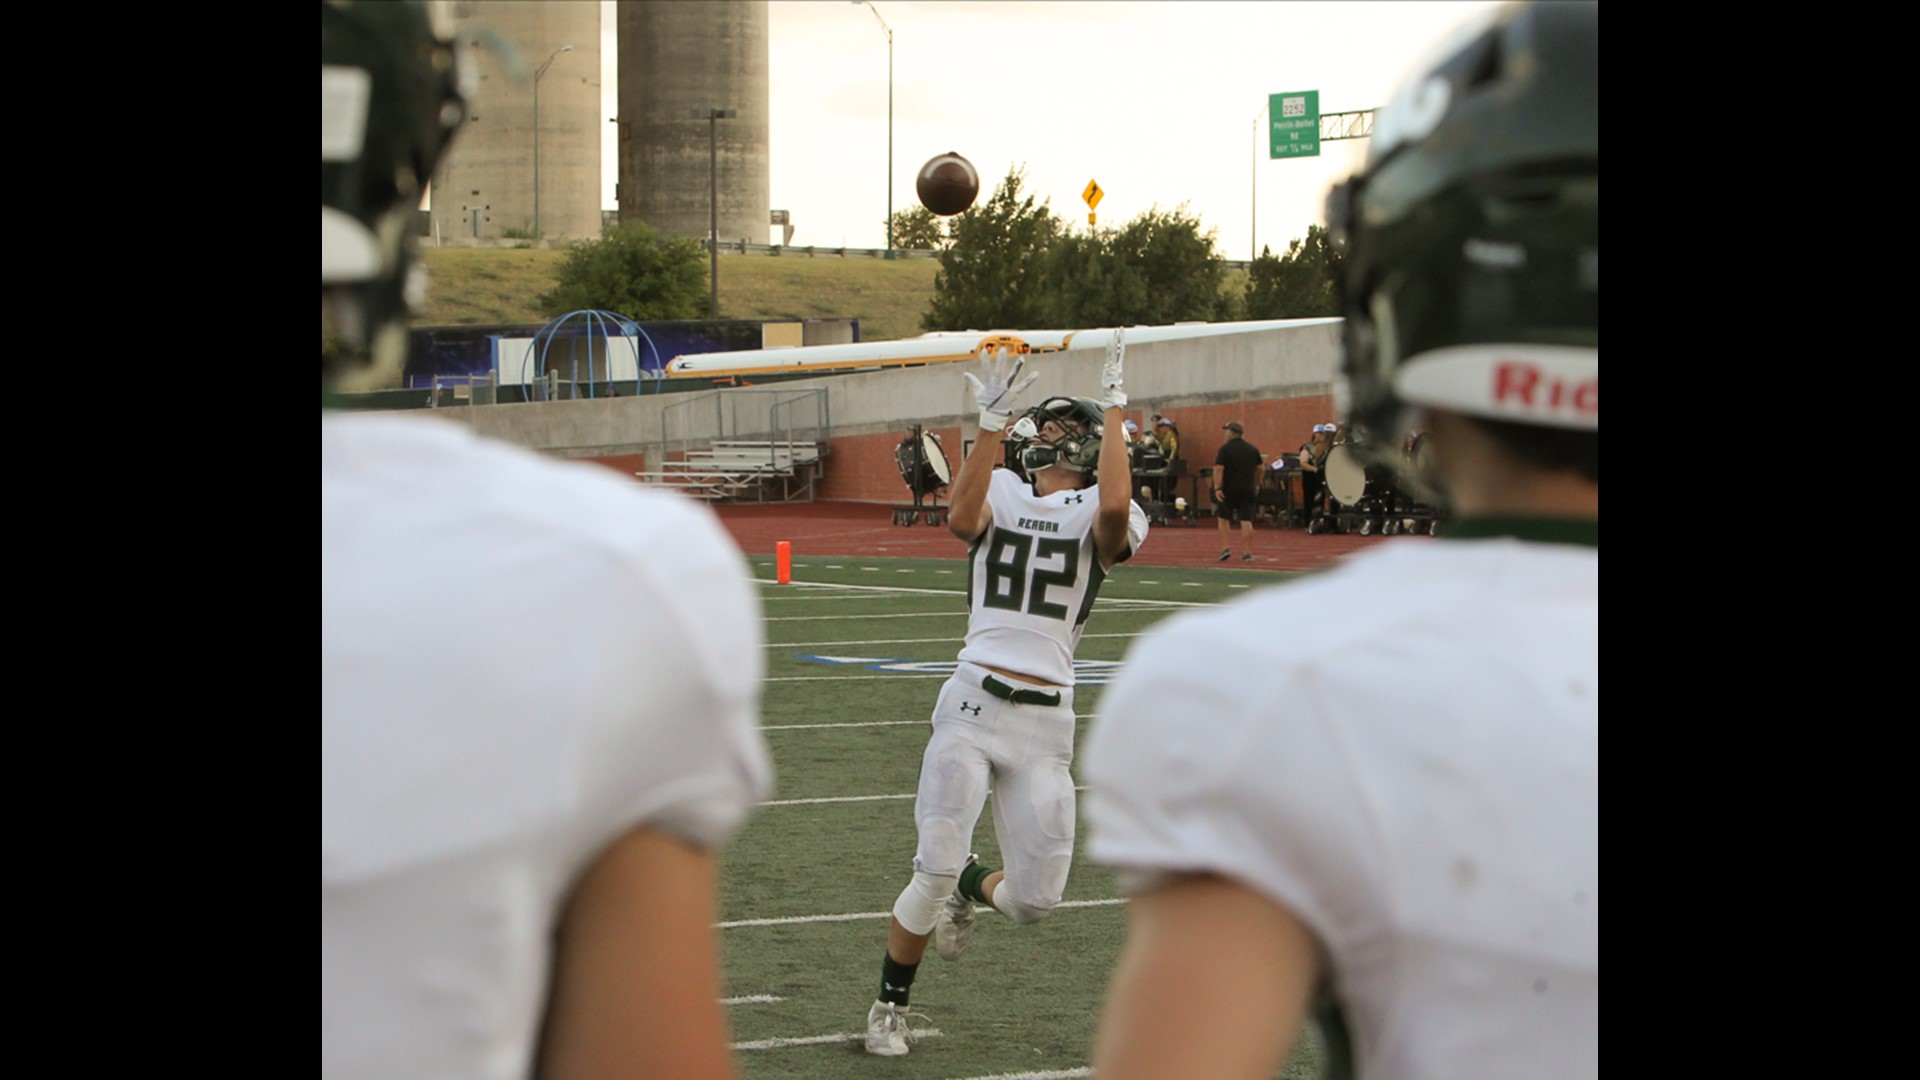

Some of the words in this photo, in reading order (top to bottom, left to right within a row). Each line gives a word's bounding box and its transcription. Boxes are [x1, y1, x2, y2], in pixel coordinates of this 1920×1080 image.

[1284, 104, 1305, 115] 2252
[1017, 517, 1060, 533] REAGAN
[983, 526, 1081, 621] 82
